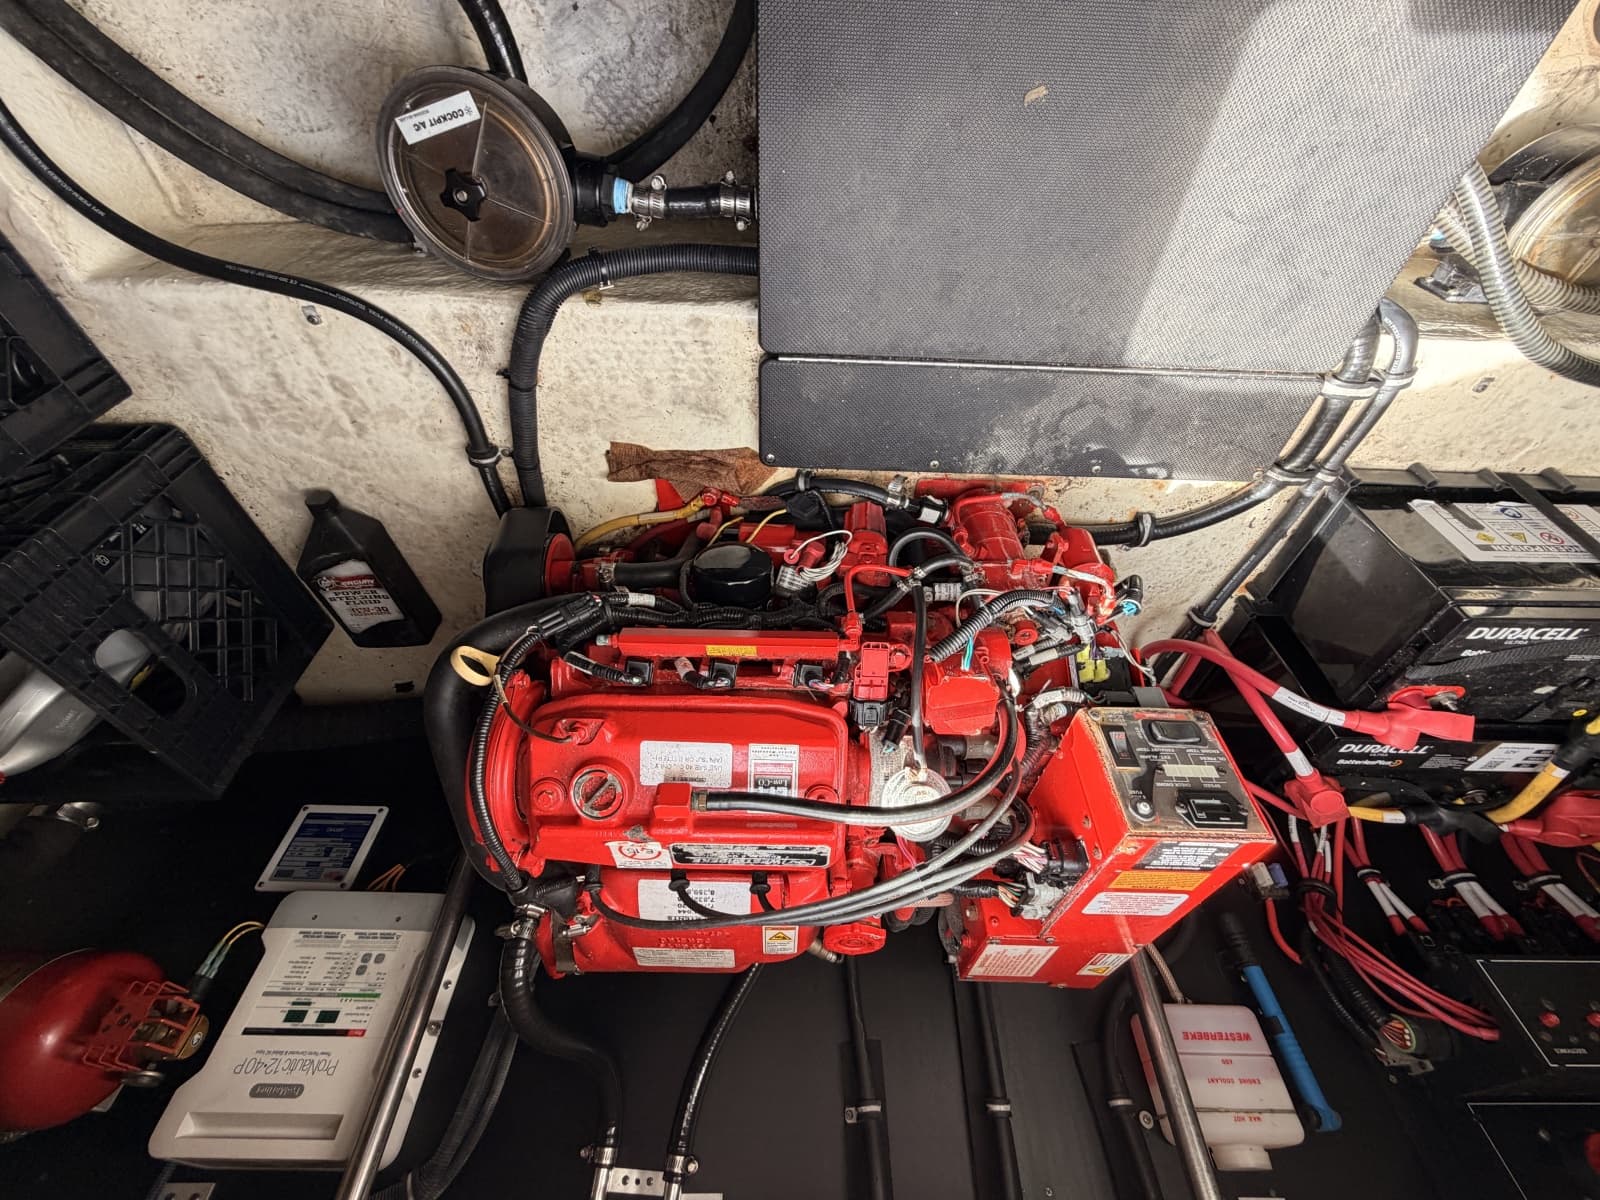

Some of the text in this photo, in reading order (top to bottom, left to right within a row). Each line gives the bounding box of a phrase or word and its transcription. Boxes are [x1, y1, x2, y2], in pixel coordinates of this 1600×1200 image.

[429, 108, 465, 127] COCKPIT
[412, 121, 427, 132] A/C
[1491, 544, 1580, 552] NGER/POISON
[1465, 627, 1585, 640] DURACELL
[1182, 1031, 1252, 1041] WESTERBEKE
[282, 1058, 339, 1076] ProNautic
